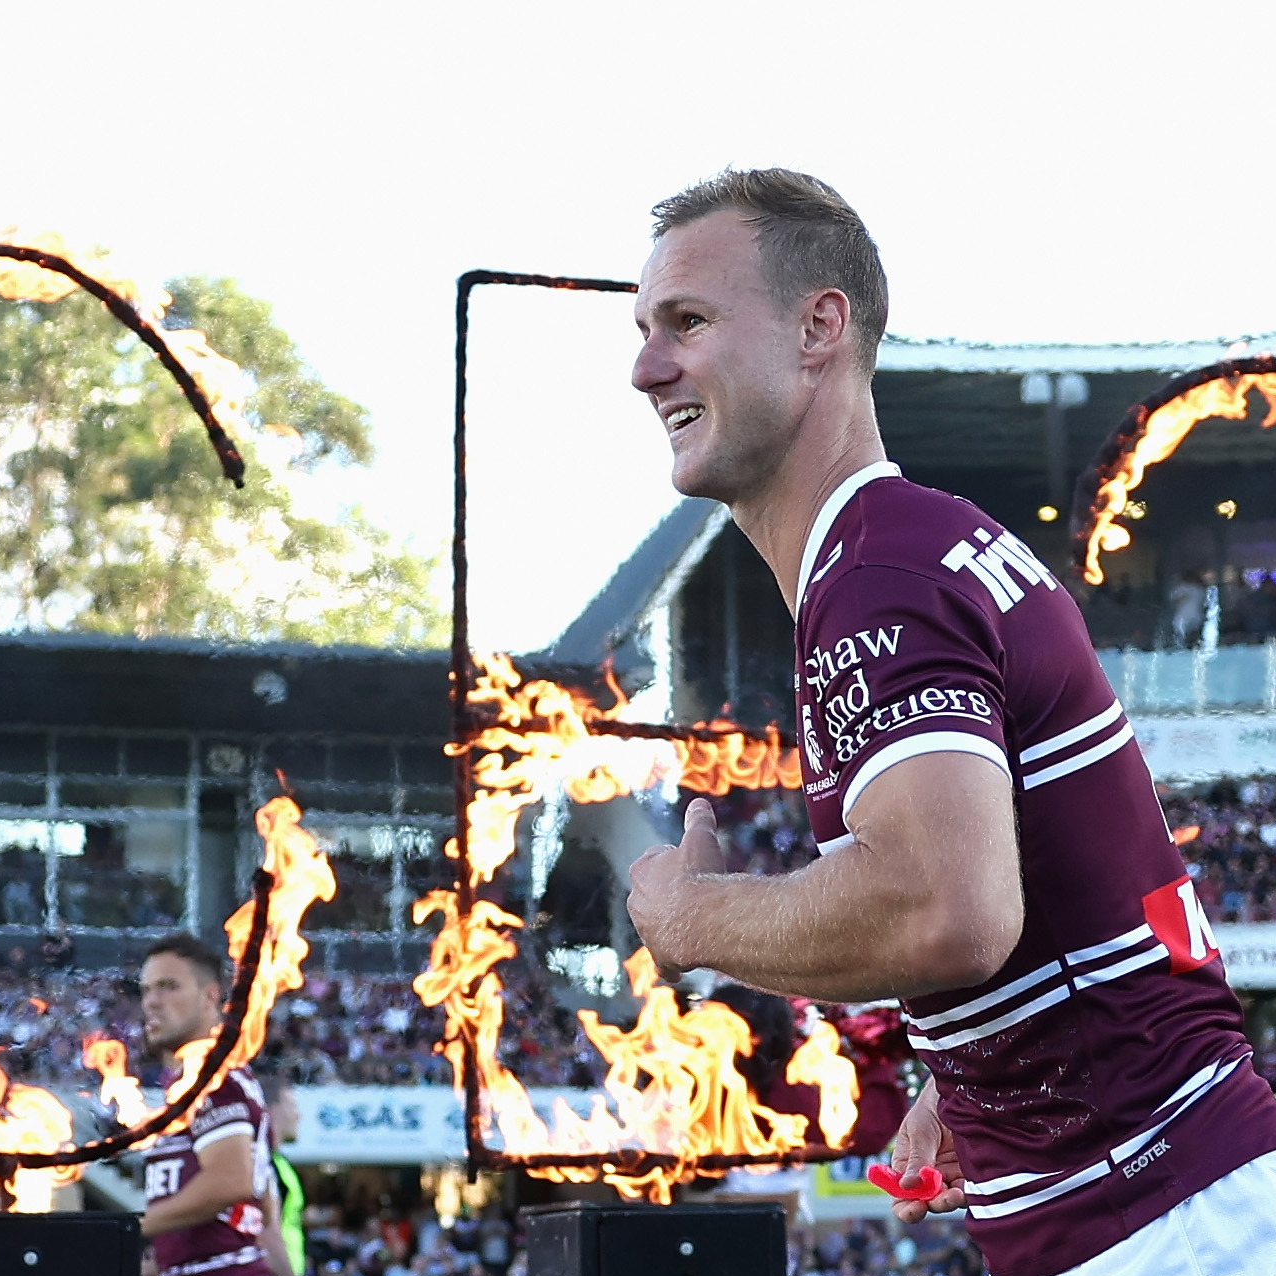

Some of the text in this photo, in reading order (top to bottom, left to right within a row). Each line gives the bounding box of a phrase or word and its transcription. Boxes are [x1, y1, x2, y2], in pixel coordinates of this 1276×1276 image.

[805, 625, 904, 703] Shaw
[836, 687, 992, 764] artners
[1122, 1138, 1172, 1180] ECOTEK
